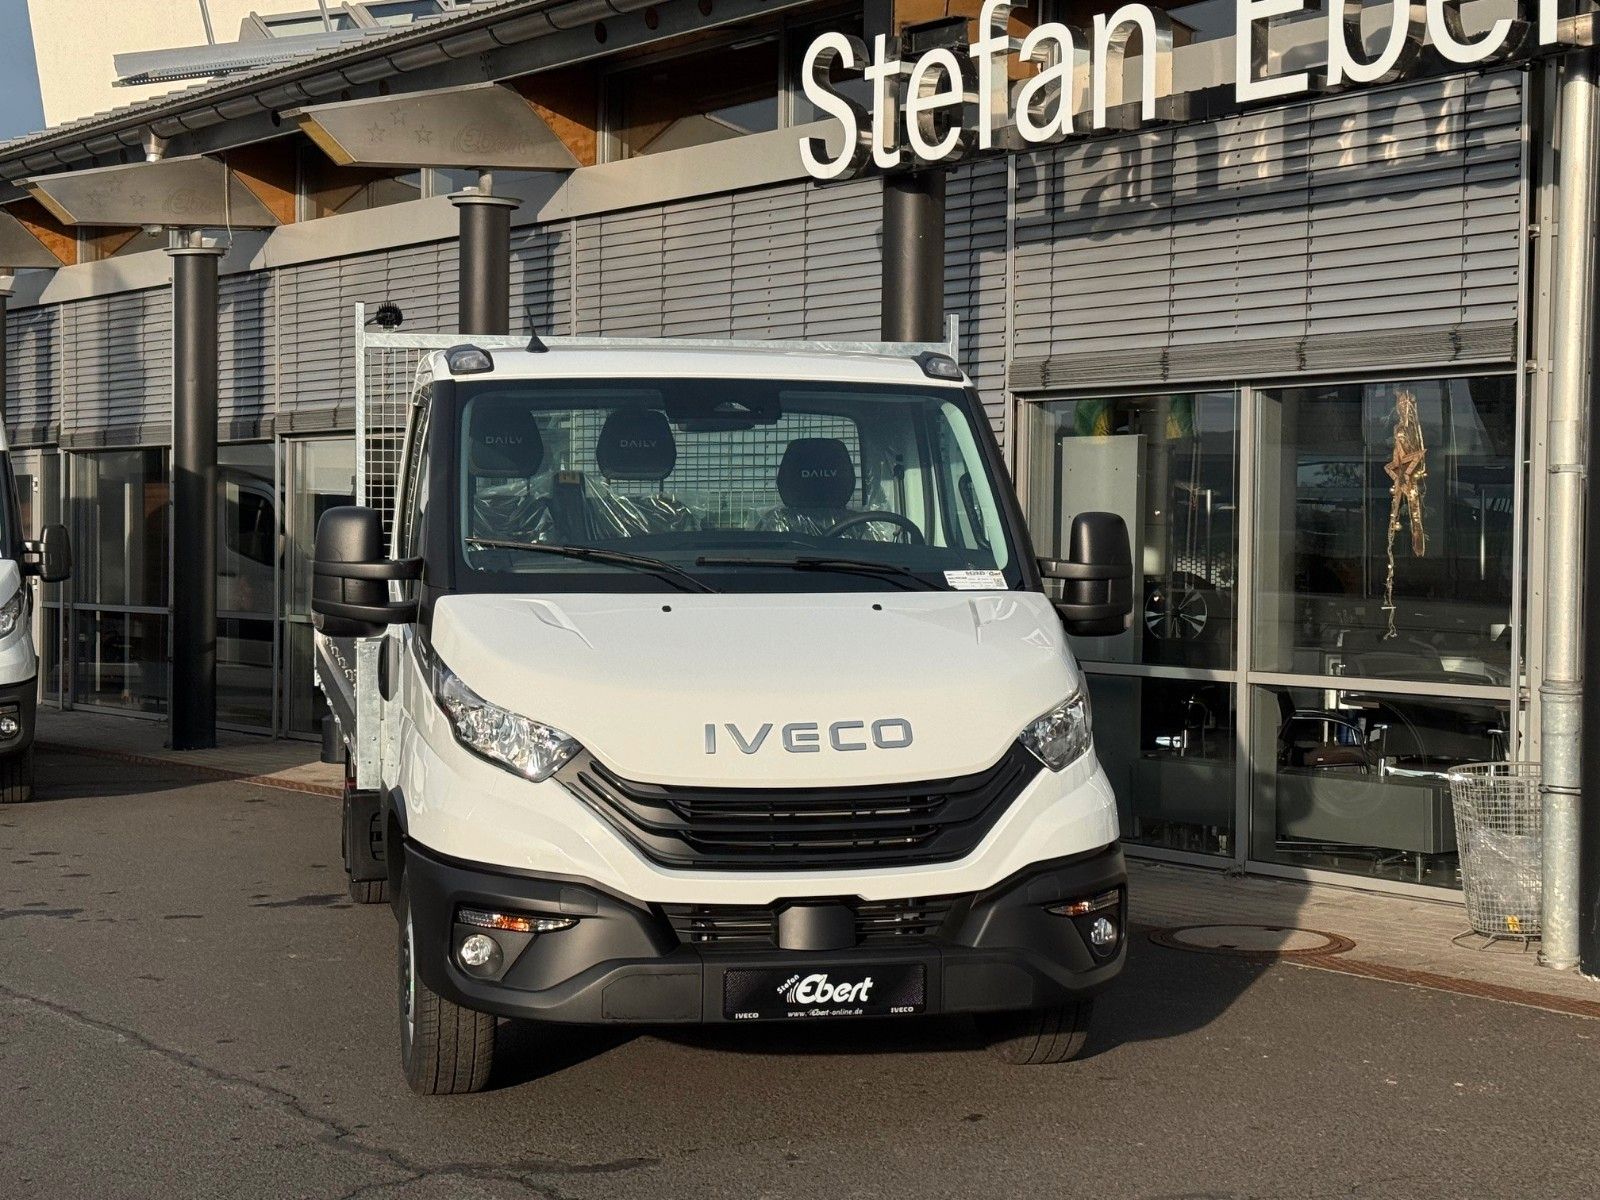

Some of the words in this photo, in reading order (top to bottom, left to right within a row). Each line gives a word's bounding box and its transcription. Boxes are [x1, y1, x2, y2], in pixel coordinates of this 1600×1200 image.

[799, 0, 1156, 180] Stefan
[485, 436, 523, 445] DAILY
[620, 439, 657, 448] DAILY
[801, 469, 838, 478] DAILY
[704, 718, 914, 755] IVECO
[776, 974, 800, 995] Stefan
[795, 973, 874, 1004] Ebert
[890, 1006, 914, 1014] IVECO
